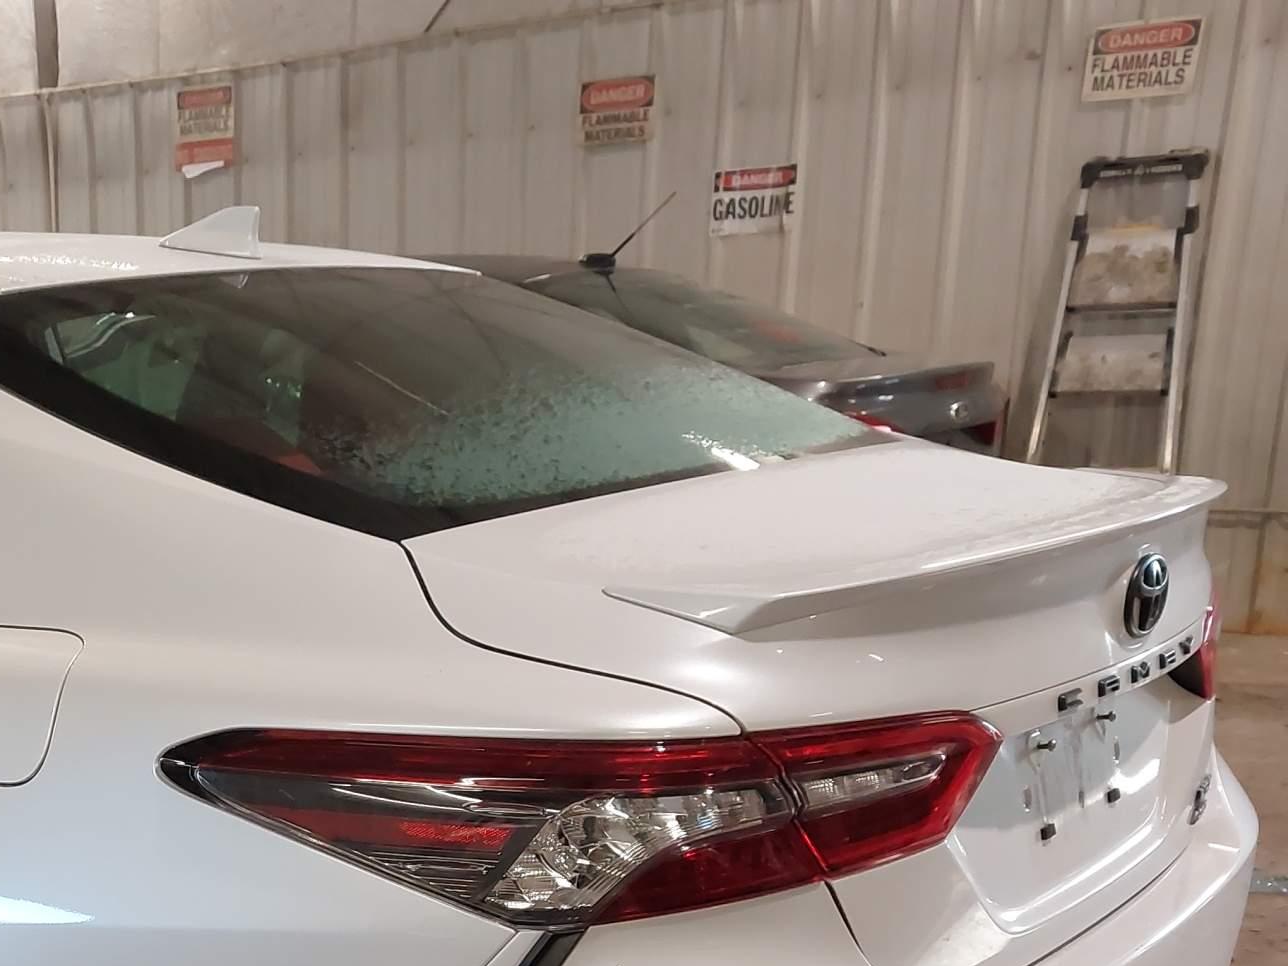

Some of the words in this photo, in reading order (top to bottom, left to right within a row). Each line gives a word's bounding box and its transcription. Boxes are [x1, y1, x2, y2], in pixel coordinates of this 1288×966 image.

[1109, 27, 1183, 48] DANGER
[1091, 48, 1193, 74] FLAMMABLE
[1092, 67, 1185, 91] MATERIALS
[590, 84, 646, 104] DANGER
[582, 108, 650, 127] FLAMMABLE
[584, 125, 645, 143] MATERIALS
[732, 171, 783, 189] DANGER
[713, 191, 795, 221] GASOLINE
